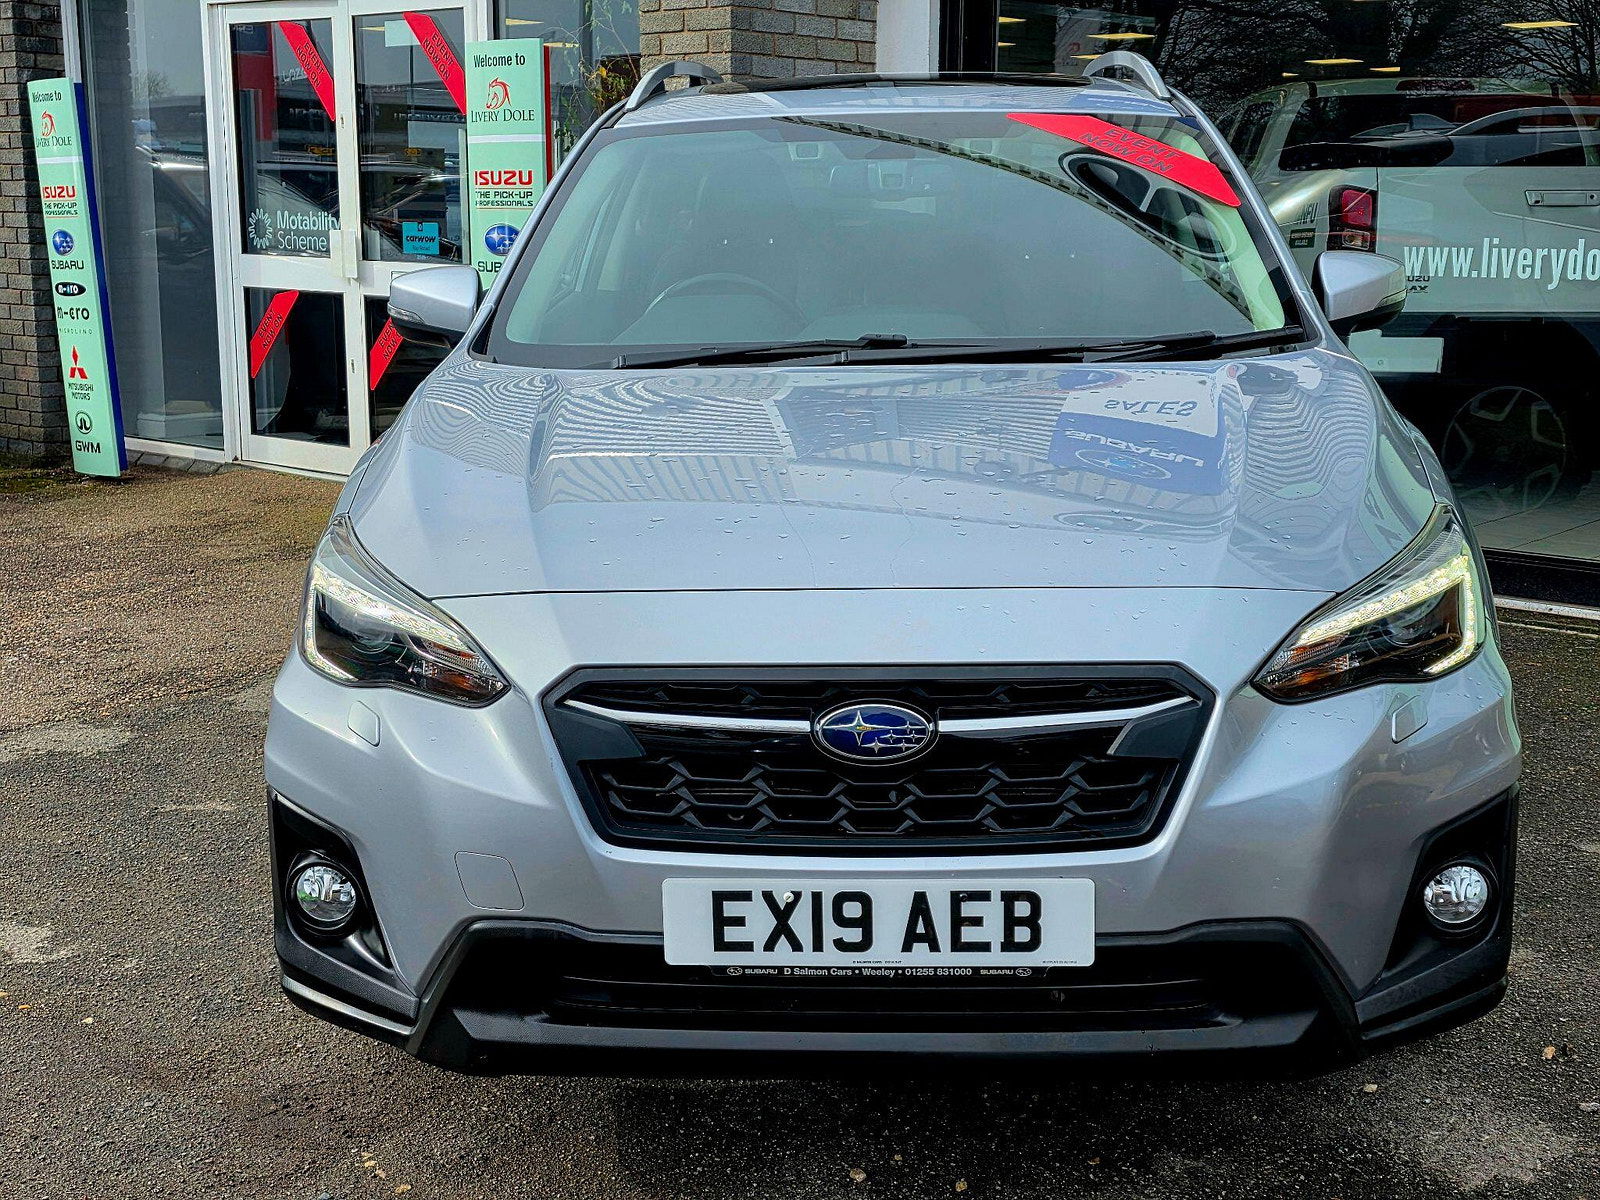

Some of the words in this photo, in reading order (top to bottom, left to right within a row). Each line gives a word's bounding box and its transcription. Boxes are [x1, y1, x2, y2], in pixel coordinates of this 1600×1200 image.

[432, 32, 454, 66] EVENT
[304, 42, 324, 74] EVENT
[423, 38, 440, 63] NOW
[438, 64, 450, 80] ON
[474, 54, 512, 68] Welcome
[515, 53, 526, 66] to
[296, 46, 311, 70] NOW
[310, 72, 320, 88] ON
[32, 91, 54, 102] Welcome
[54, 90, 62, 101] to
[471, 110, 500, 123] LIVERY
[503, 108, 534, 122] DOLE
[51, 135, 72, 147] DOLE
[1103, 128, 1184, 159] EVENT
[1078, 133, 1136, 157] NOW
[1136, 154, 1174, 172] ON
[474, 170, 533, 186] ISUZU
[42, 186, 76, 199] ISUZU
[476, 191, 490, 199] THE
[494, 190, 533, 199] PICK-UP
[276, 210, 341, 232] Motability
[278, 231, 327, 250] Scheme
[51, 260, 84, 270] SUBARU
[258, 308, 274, 338] EVENT
[262, 329, 276, 350] NOW
[274, 314, 283, 328] ON
[383, 337, 398, 360] NOW
[68, 382, 94, 392] MITSUBISHI
[72, 392, 90, 400] MOTORS
[75, 440, 102, 454] GWM
[712, 890, 873, 952] EX19
[900, 890, 1042, 953] AEB
[794, 968, 828, 976] Salmon
[830, 968, 852, 976] Cars
[862, 968, 896, 977] Weeley
[904, 968, 934, 976] 01255
[936, 968, 973, 976] 831000
